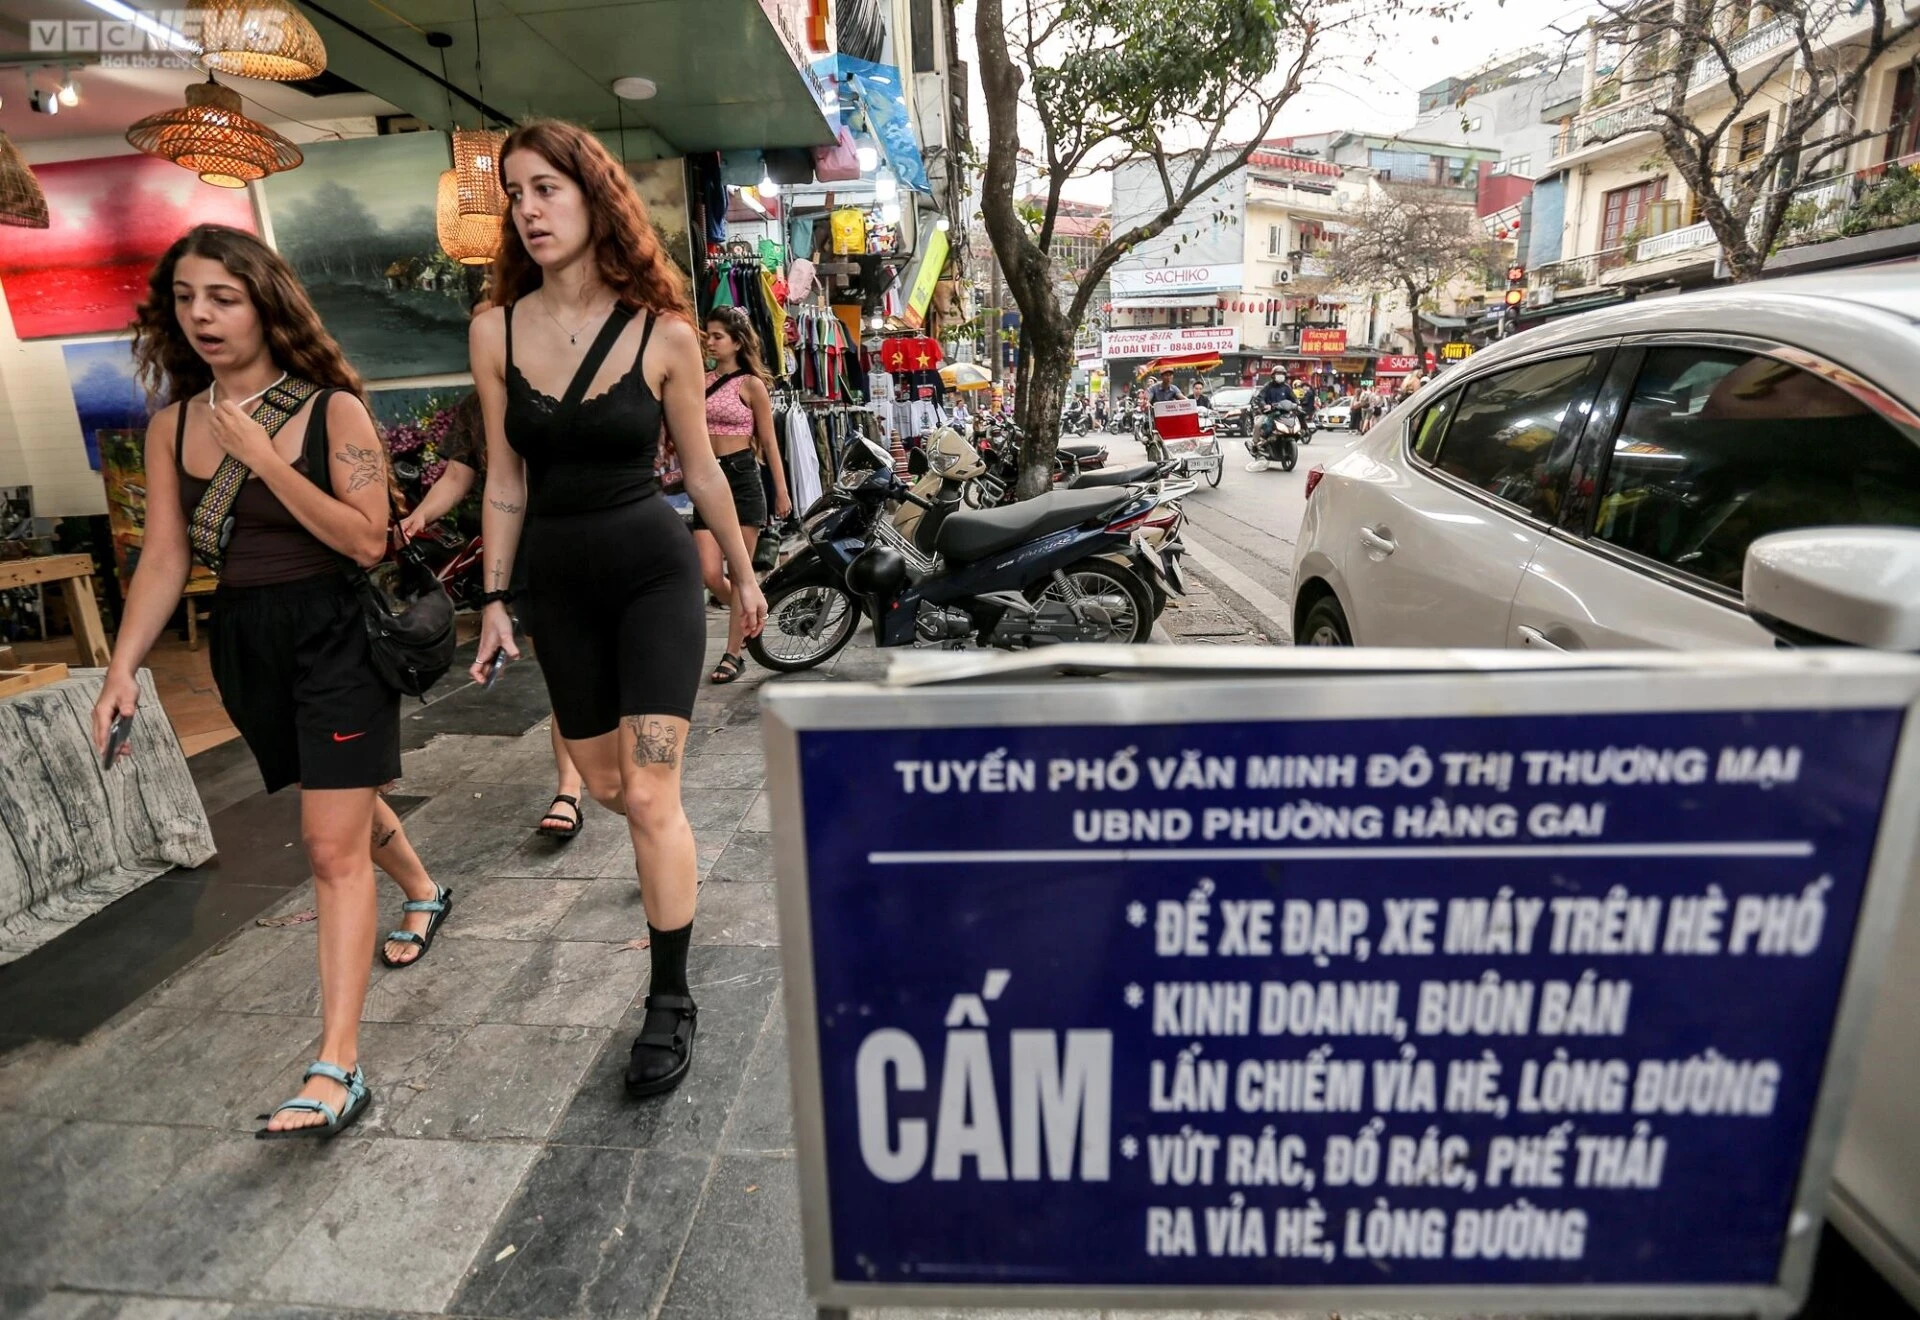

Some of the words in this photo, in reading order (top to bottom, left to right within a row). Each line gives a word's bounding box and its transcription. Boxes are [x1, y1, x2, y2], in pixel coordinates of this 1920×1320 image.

[1145, 268, 1209, 284] SACHIKO
[1141, 341, 1161, 355] VIỆT
[894, 747, 1035, 793] TUYẾN
[1047, 745, 1139, 791] PHỐ
[1148, 749, 1236, 790] VĂN
[1245, 755, 1357, 789] MINH
[1365, 745, 1433, 787] ĐÔ
[1439, 752, 1513, 792] THỊ
[1522, 746, 1707, 785] THƯƠNG
[1716, 746, 1802, 790] MẠI
[1073, 808, 1192, 842] UBND
[1203, 798, 1383, 840] PHƯỜNG
[1393, 797, 1518, 838] HÀNG
[1527, 803, 1606, 837] GAI
[1154, 877, 1215, 957] ĐỂ
[1217, 899, 1275, 956] XE
[1280, 899, 1371, 968] ĐẠP,
[1377, 898, 1440, 955] XE
[1443, 885, 1545, 955] MÁY
[1548, 884, 1662, 955] TRÊN
[1662, 882, 1728, 955] HÈ
[1728, 873, 1834, 957] PHỐ
[1153, 980, 1252, 1036] KINH
[1258, 980, 1408, 1042] DOANH,
[1416, 968, 1535, 1036] BUÔN
[1537, 968, 1632, 1036] BÁN
[855, 968, 1114, 1184] CẤM
[1149, 1041, 1228, 1113] LẤN
[1235, 1043, 1366, 1113] CHIẾM
[1372, 1041, 1438, 1113] VỈA
[1444, 1048, 1509, 1120] HÈ,
[1516, 1047, 1630, 1114] LÒNG
[1631, 1047, 1782, 1117] ĐƯỜNG
[1146, 1123, 1220, 1187] VỨT
[1226, 1123, 1316, 1193] RÁC,
[1323, 1115, 1386, 1187] ĐỔ
[1385, 1124, 1477, 1193] RÁC,
[1485, 1120, 1568, 1188] PHẾ
[1574, 1120, 1668, 1188] THẢI
[1146, 1206, 1197, 1257] RA
[1205, 1191, 1267, 1258] VỈA
[1275, 1197, 1335, 1264] HÈ,
[1343, 1197, 1447, 1259] LÒNG
[1452, 1197, 1588, 1260] ĐƯỜNG
